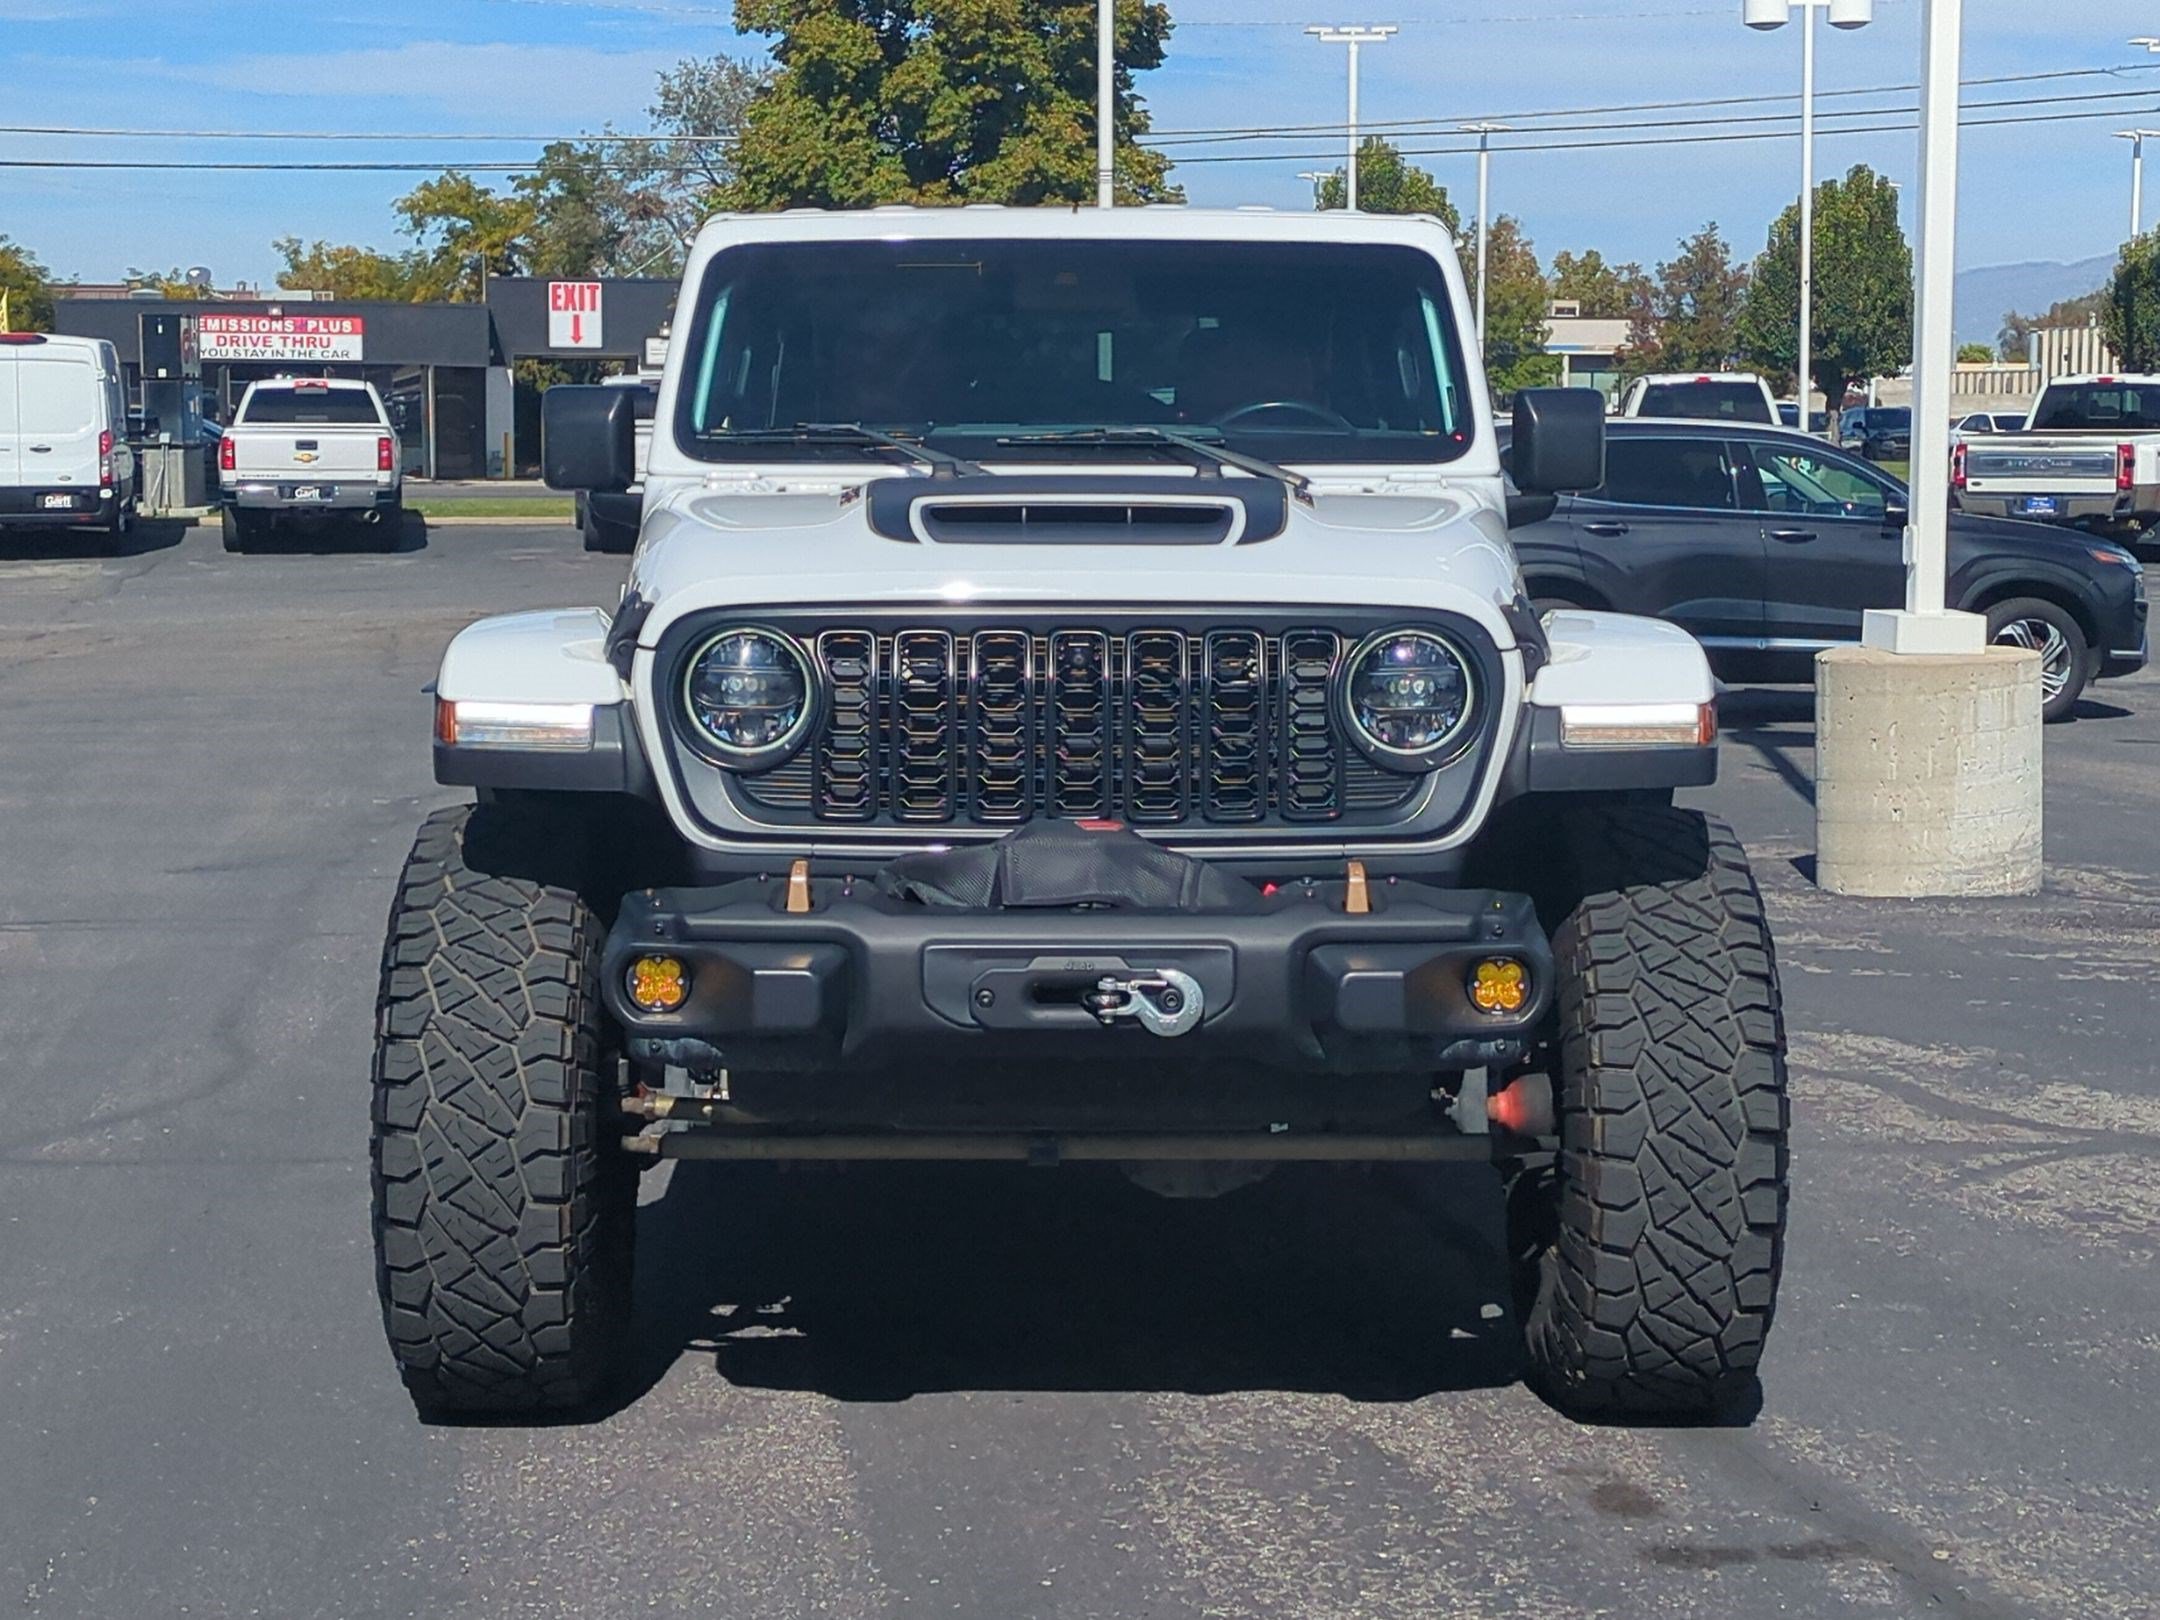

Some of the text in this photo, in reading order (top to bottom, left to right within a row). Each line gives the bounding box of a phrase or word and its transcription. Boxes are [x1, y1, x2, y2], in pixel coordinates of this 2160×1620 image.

[551, 284, 600, 311] EXIT
[199, 318, 353, 333] EMISSIONS PLUS
[216, 335, 331, 348] DRIVE THRU
[200, 348, 351, 359] YOU STAY IN THE CAR
